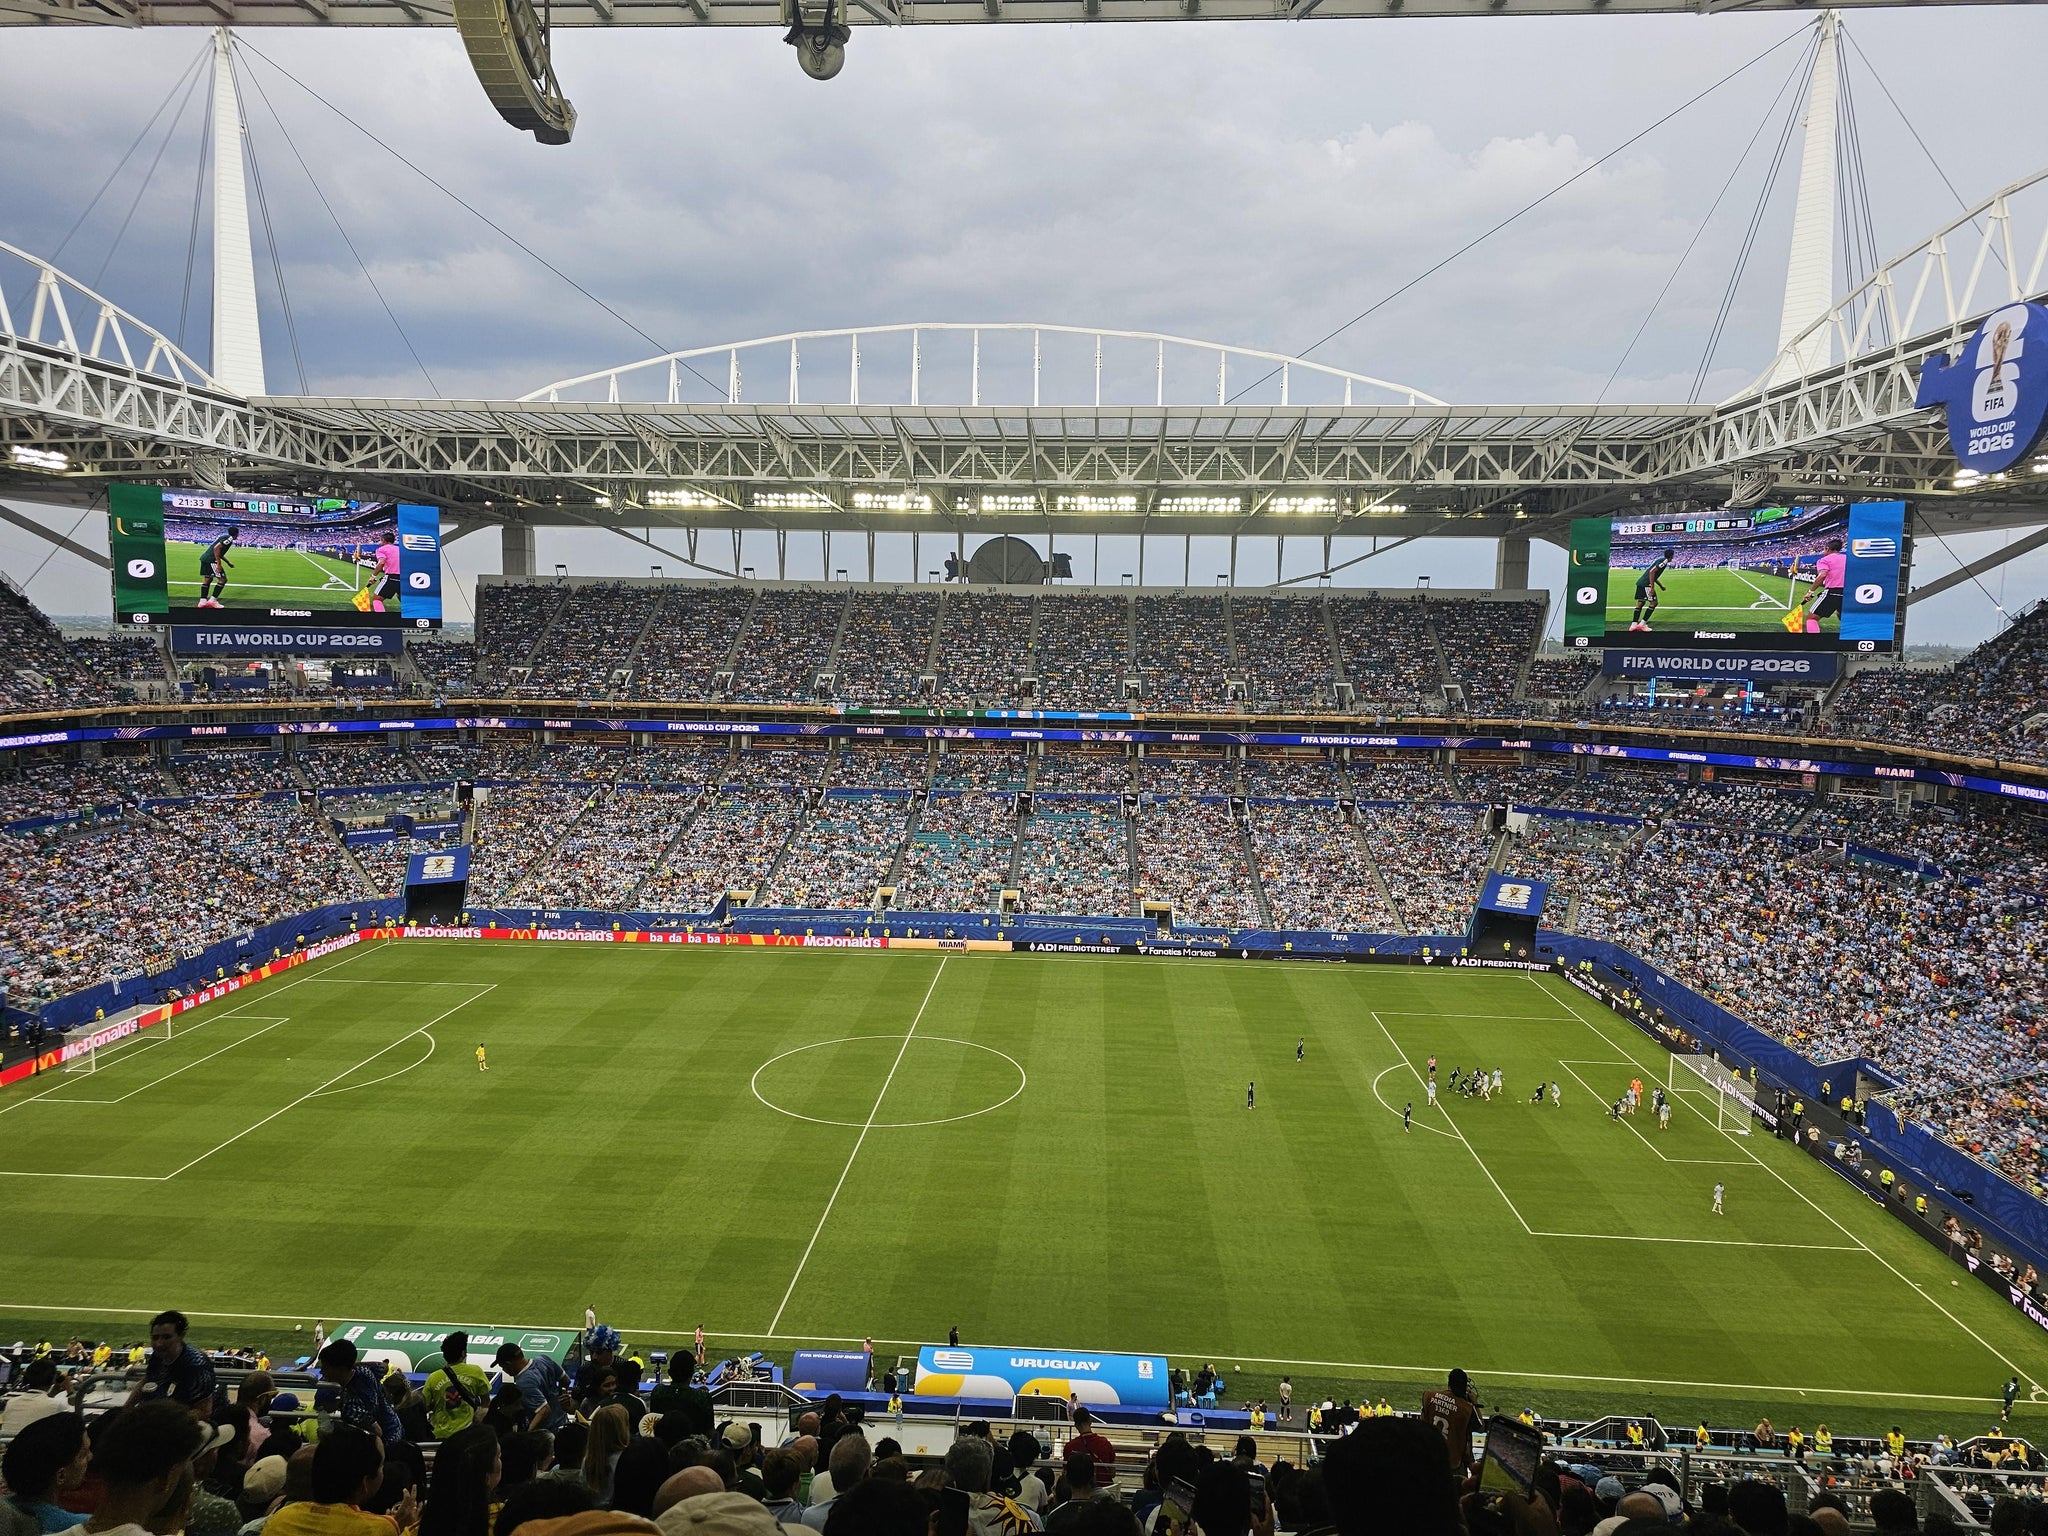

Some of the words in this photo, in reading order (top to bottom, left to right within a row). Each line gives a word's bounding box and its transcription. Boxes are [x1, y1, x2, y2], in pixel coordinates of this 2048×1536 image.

[1984, 397, 2004, 411] FIFA
[1970, 424, 1997, 438] WORLD
[1999, 421, 2016, 432] CUP
[1968, 433, 2015, 455] 2026
[179, 499, 205, 507] 21:33
[1624, 525, 1647, 533] 21:33
[270, 608, 312, 617] Hisense
[134, 614, 148, 623] CC
[197, 633, 232, 645] FIFA
[235, 633, 294, 646] WORLD
[296, 634, 328, 646] CUP
[330, 635, 382, 646] 2026
[1694, 630, 1737, 639] Hisense
[1859, 642, 1873, 650] CC
[1623, 656, 1655, 669] FIFA
[1657, 657, 1713, 670] WORLD
[1715, 658, 1748, 671] CUP
[1751, 659, 1810, 673] 2026
[1890, 662, 1907, 670] 327
[544, 720, 572, 728] MIAMI
[667, 723, 686, 731] FIFA
[686, 723, 714, 731] WORLD
[191, 726, 227, 735] MIAMI
[856, 727, 884, 735] MIAMI
[25, 735, 41, 744] CUP
[41, 732, 68, 743] 2026
[1301, 736, 1319, 744] FIFA
[1350, 737, 1367, 745] CUP
[1502, 740, 1531, 748] MIAMI
[1874, 767, 1915, 777] MIAMI
[2000, 783, 2017, 795] FIFA
[2017, 786, 2046, 800] WORLD
[545, 912, 560, 920] FIFA
[403, 926, 482, 939] McDonald's
[537, 929, 615, 942] McDonald's
[650, 931, 663, 942] ba
[669, 932, 682, 943] da
[688, 933, 701, 943] ba
[707, 933, 720, 944] ba
[725, 934, 739, 944] ba
[803, 935, 881, 948] McDonald's
[1331, 934, 1348, 942] FIFA
[236, 938, 249, 948] FIFA
[307, 932, 360, 961] McDonald's
[1037, 943, 1057, 952] ADI
[1058, 945, 1121, 954] PREDICTSTREET
[1149, 947, 1182, 956] Fanatics
[1183, 948, 1217, 958] Markets
[1459, 957, 1481, 967] ADI
[1482, 960, 1551, 972] PREDICTSTREET
[1656, 975, 1666, 986] FIFA
[183, 999, 195, 1011] ba
[198, 991, 210, 1004] da
[214, 986, 225, 999] ba
[229, 980, 240, 993] ba
[242, 973, 253, 986] ba
[1569, 973, 1586, 990] Fanatics
[1585, 984, 1602, 1001] Markets
[61, 1019, 138, 1062] McDonald's
[1721, 1080, 1737, 1097] ADI
[1736, 1090, 1779, 1127] PREDICTSTREE
[373, 1330, 433, 1343] SAUDI
[1010, 1357, 1101, 1371] URUGUAY
[1435, 1392, 1456, 1404] MEDIA
[1430, 1397, 1458, 1412] PARTNER
